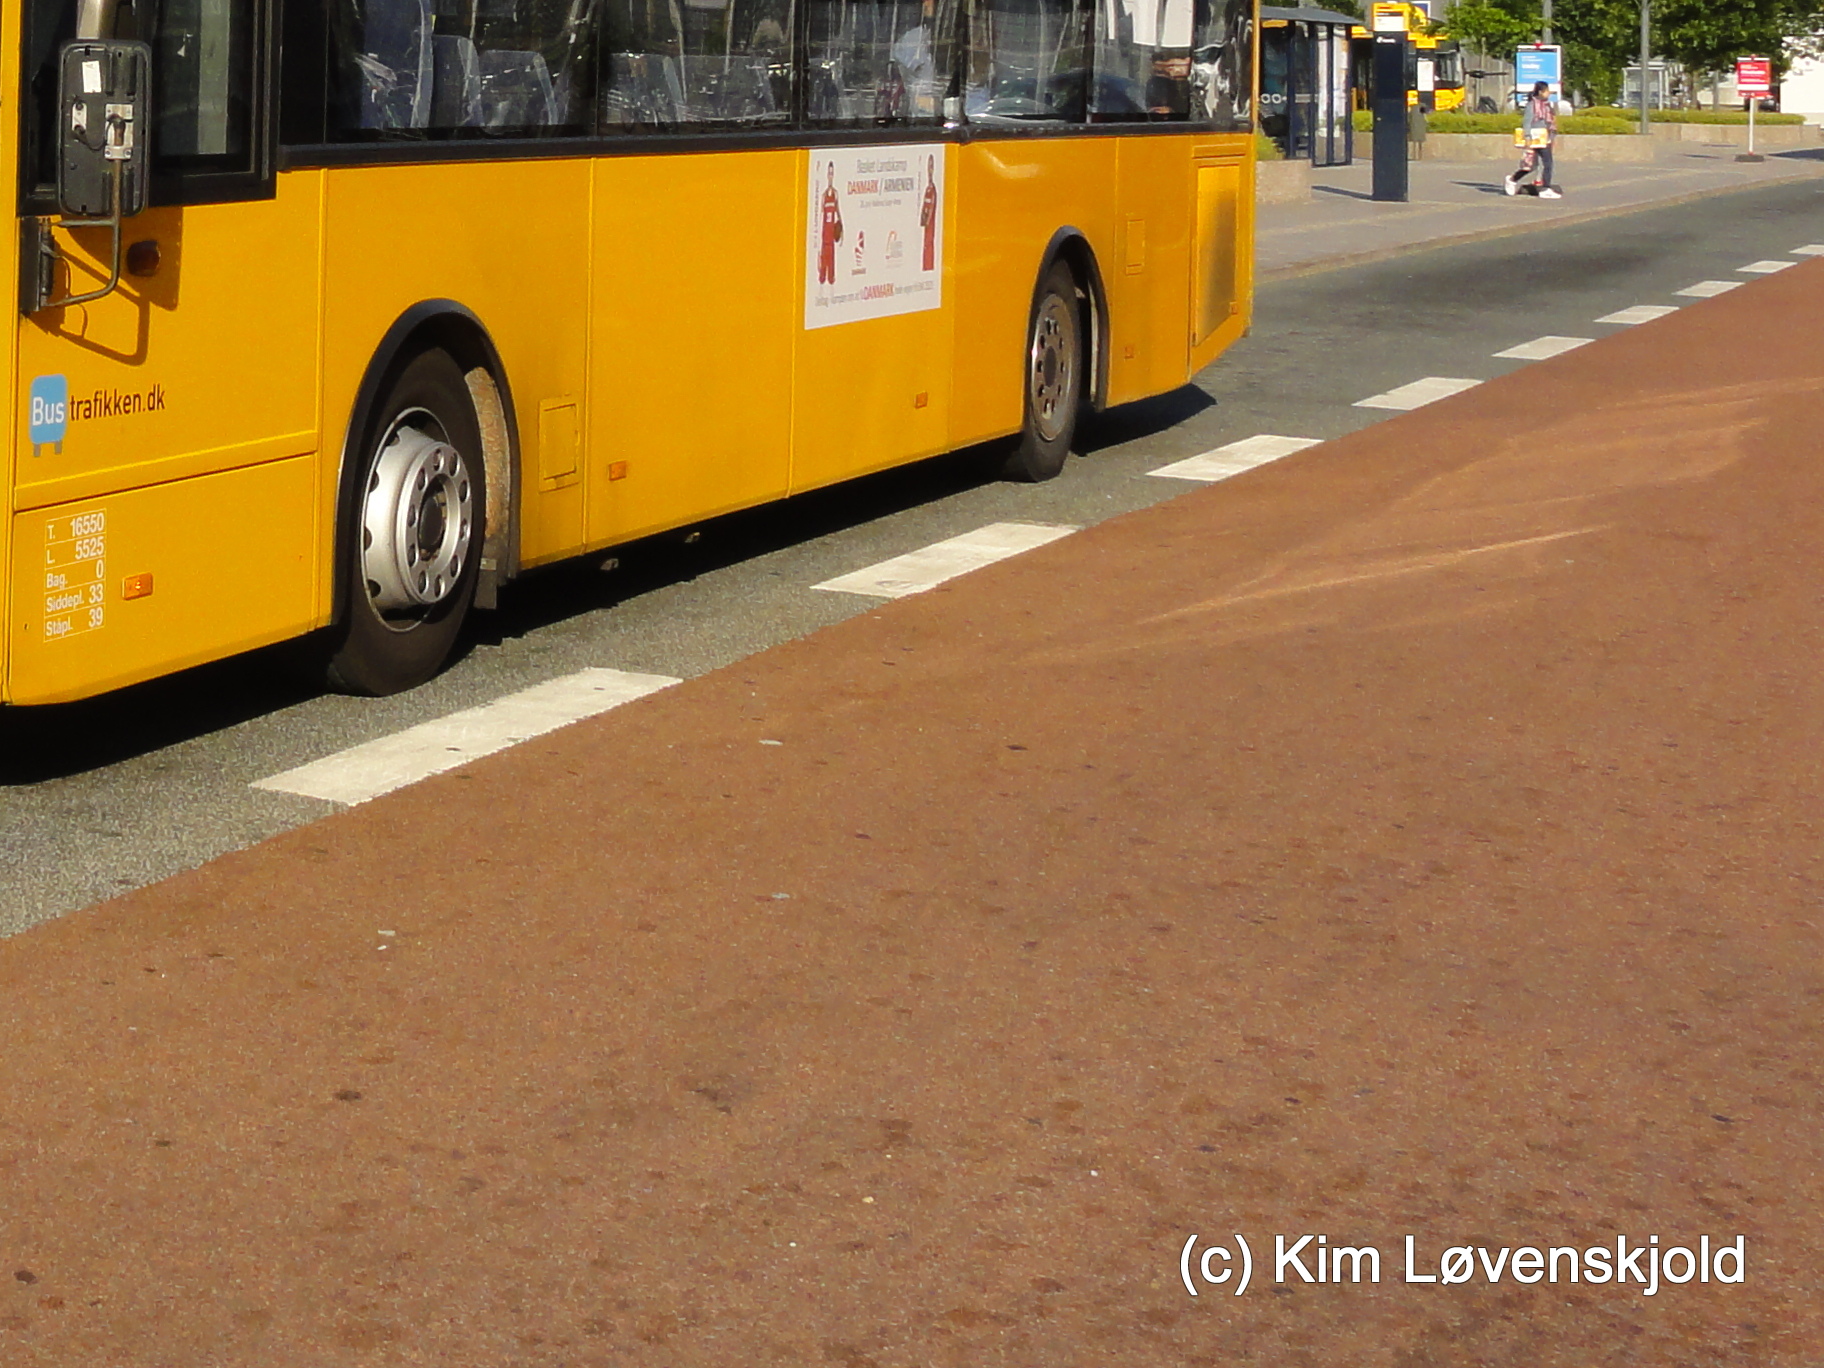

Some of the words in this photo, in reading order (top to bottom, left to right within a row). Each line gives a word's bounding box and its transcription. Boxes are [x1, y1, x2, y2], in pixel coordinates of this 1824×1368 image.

[847, 179, 879, 195] DANMARK
[70, 512, 104, 537] 16550
[75, 536, 104, 560] 5525
[96, 559, 104, 578] 0
[46, 589, 85, 613] Siddepl.
[89, 583, 103, 604] 33
[88, 607, 103, 628] 39
